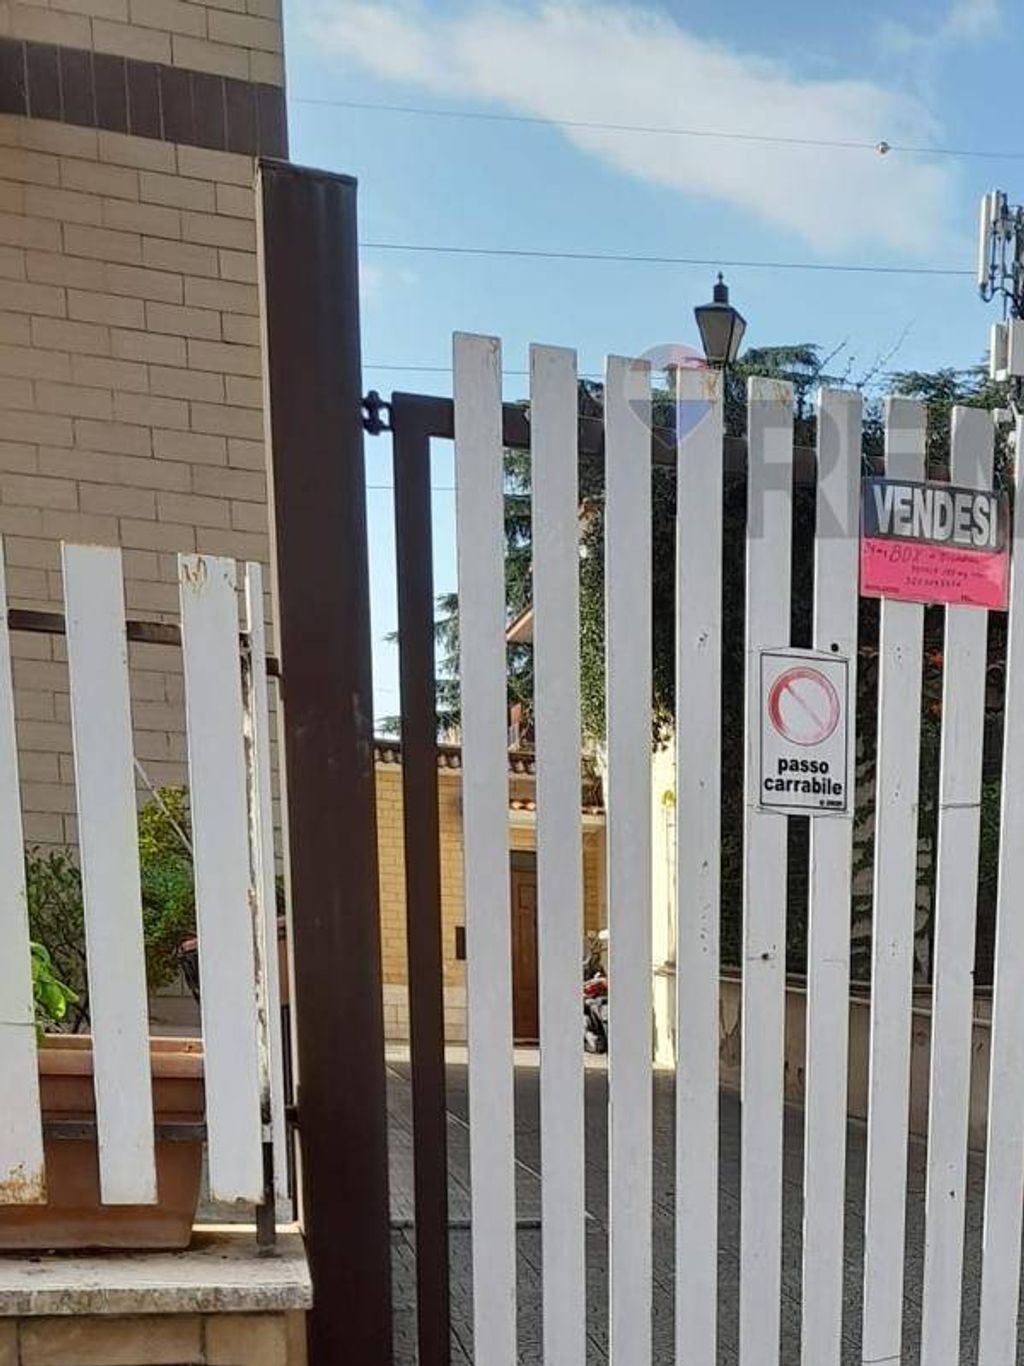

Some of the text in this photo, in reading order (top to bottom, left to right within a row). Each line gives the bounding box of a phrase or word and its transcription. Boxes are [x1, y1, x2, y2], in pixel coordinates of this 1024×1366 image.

[873, 485, 998, 548] VENDESI
[778, 758, 829, 783] passo
[764, 777, 843, 796] carrabile
